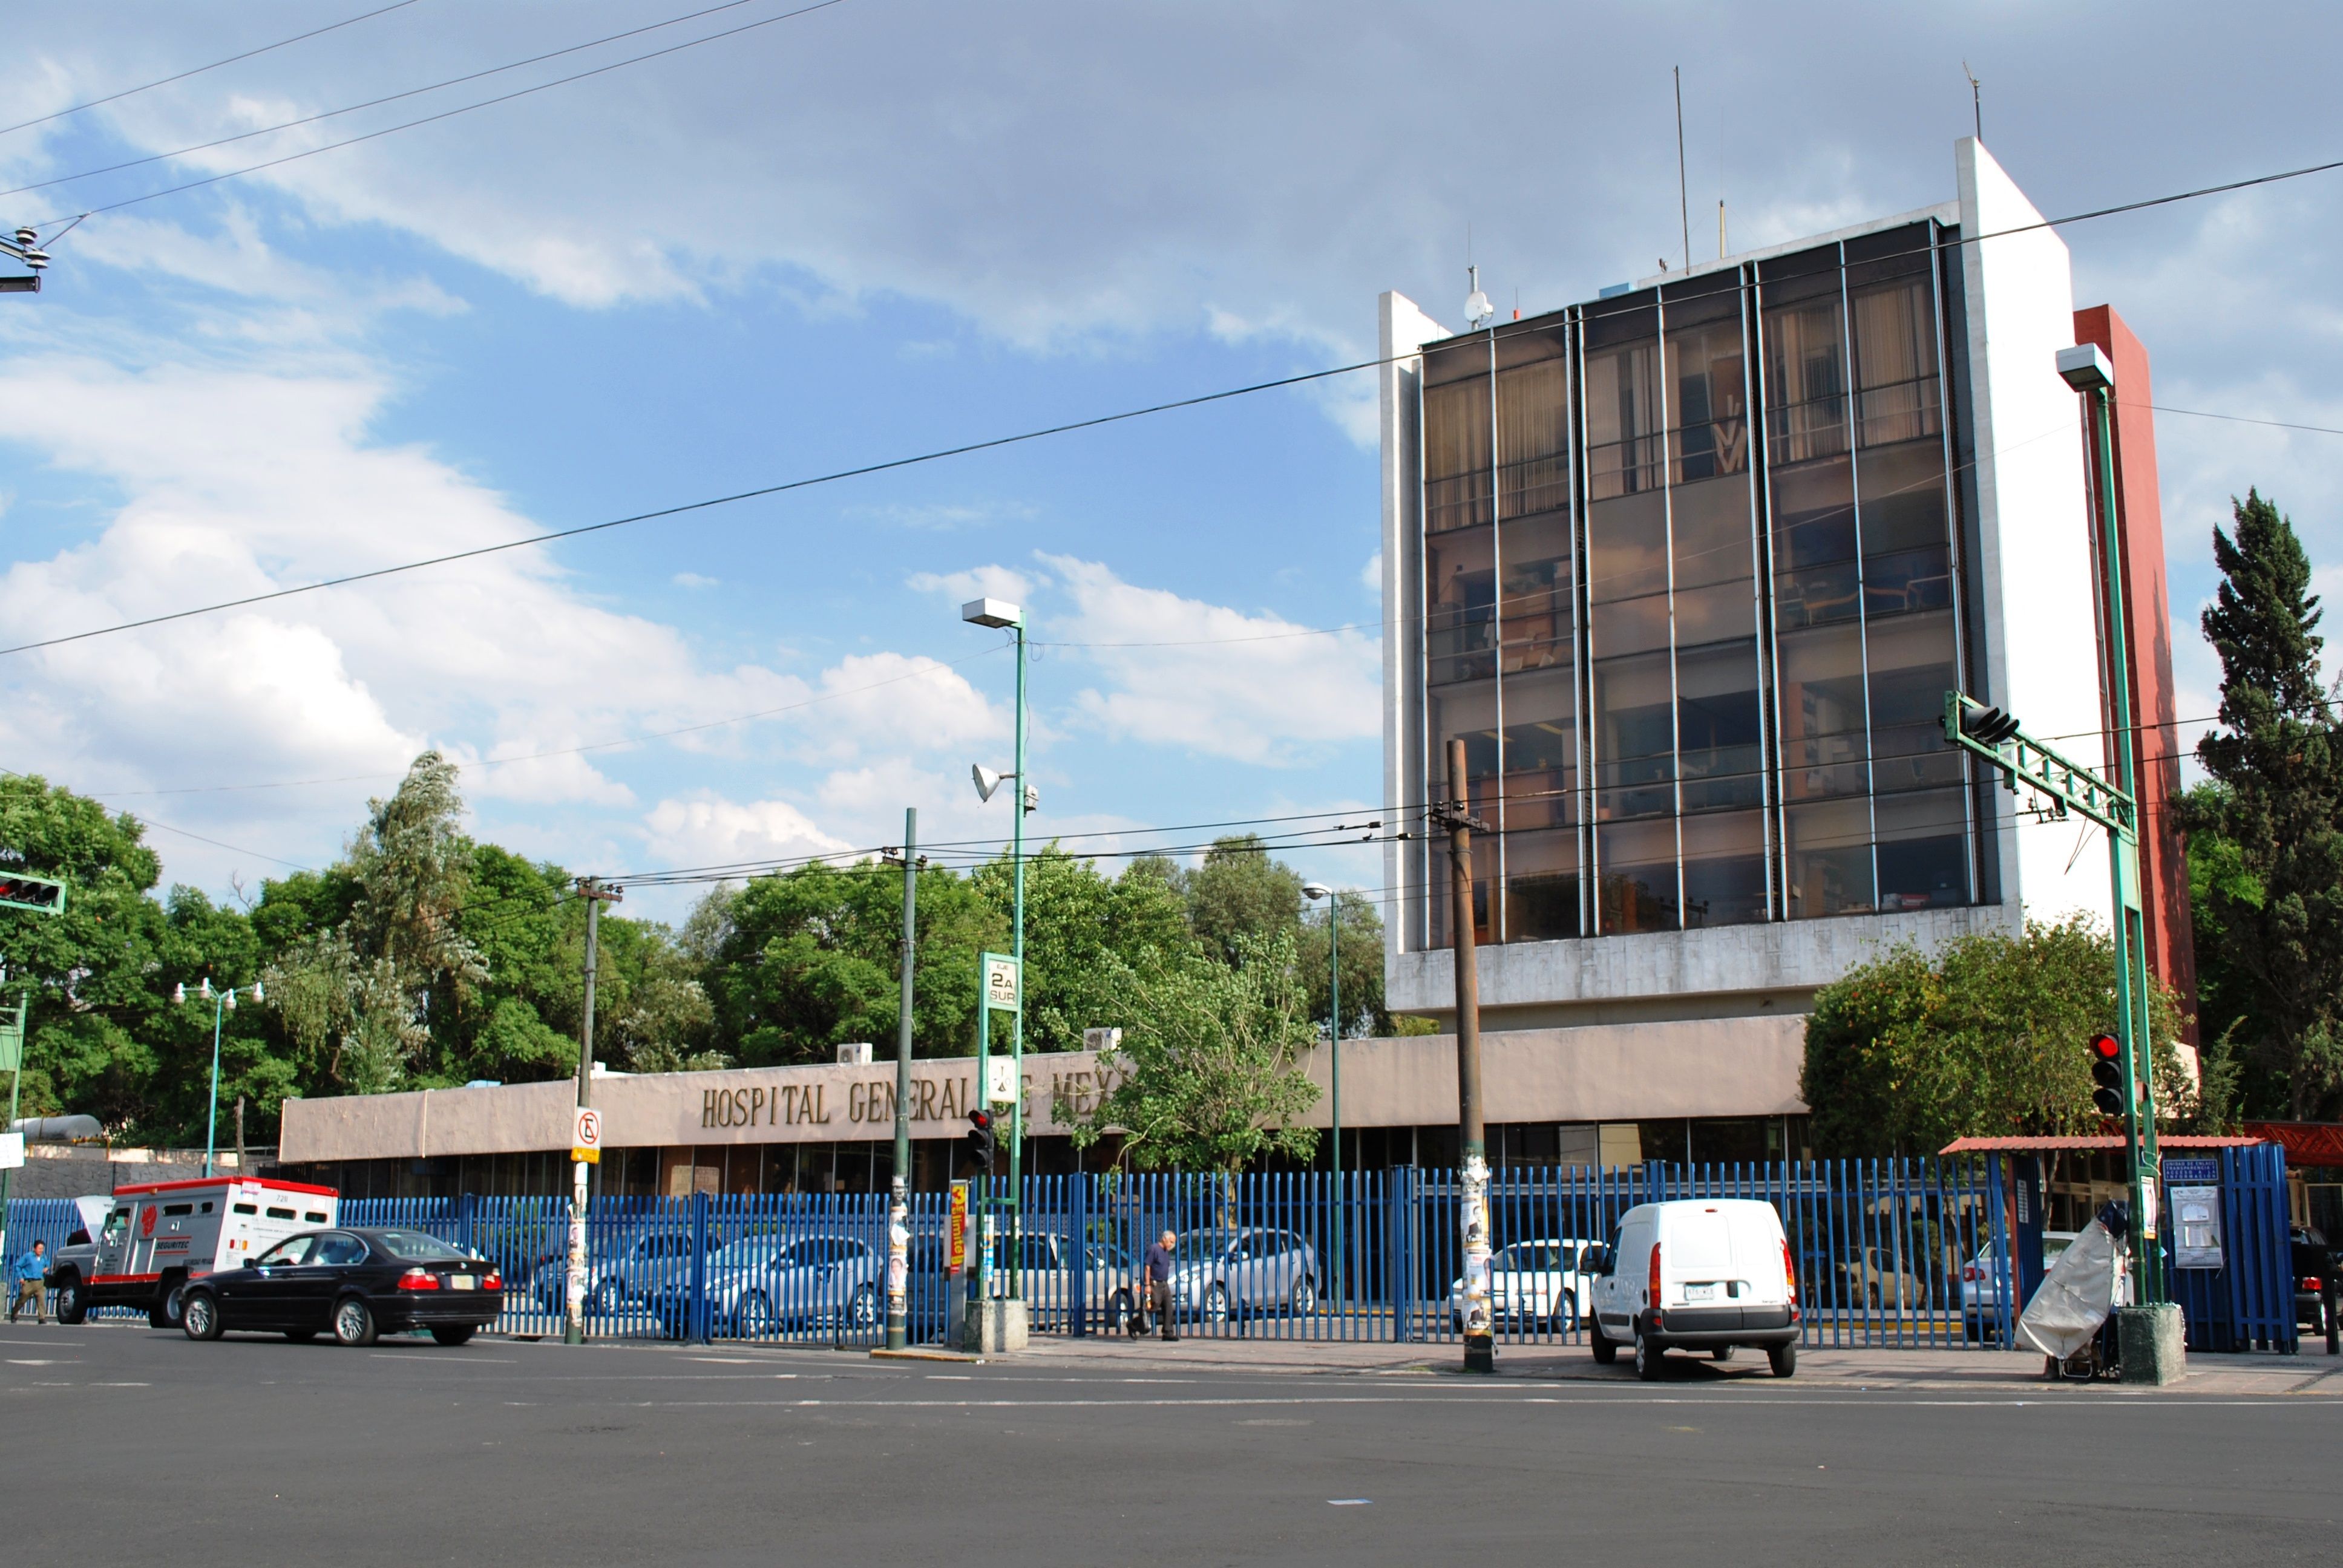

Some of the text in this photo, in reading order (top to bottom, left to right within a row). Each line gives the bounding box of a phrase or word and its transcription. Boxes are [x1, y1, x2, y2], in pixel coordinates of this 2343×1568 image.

[990, 990, 1015, 1002] SUR
[701, 1084, 830, 1128] HOSPITAL
[156, 1241, 189, 1250] SEGURITEC
